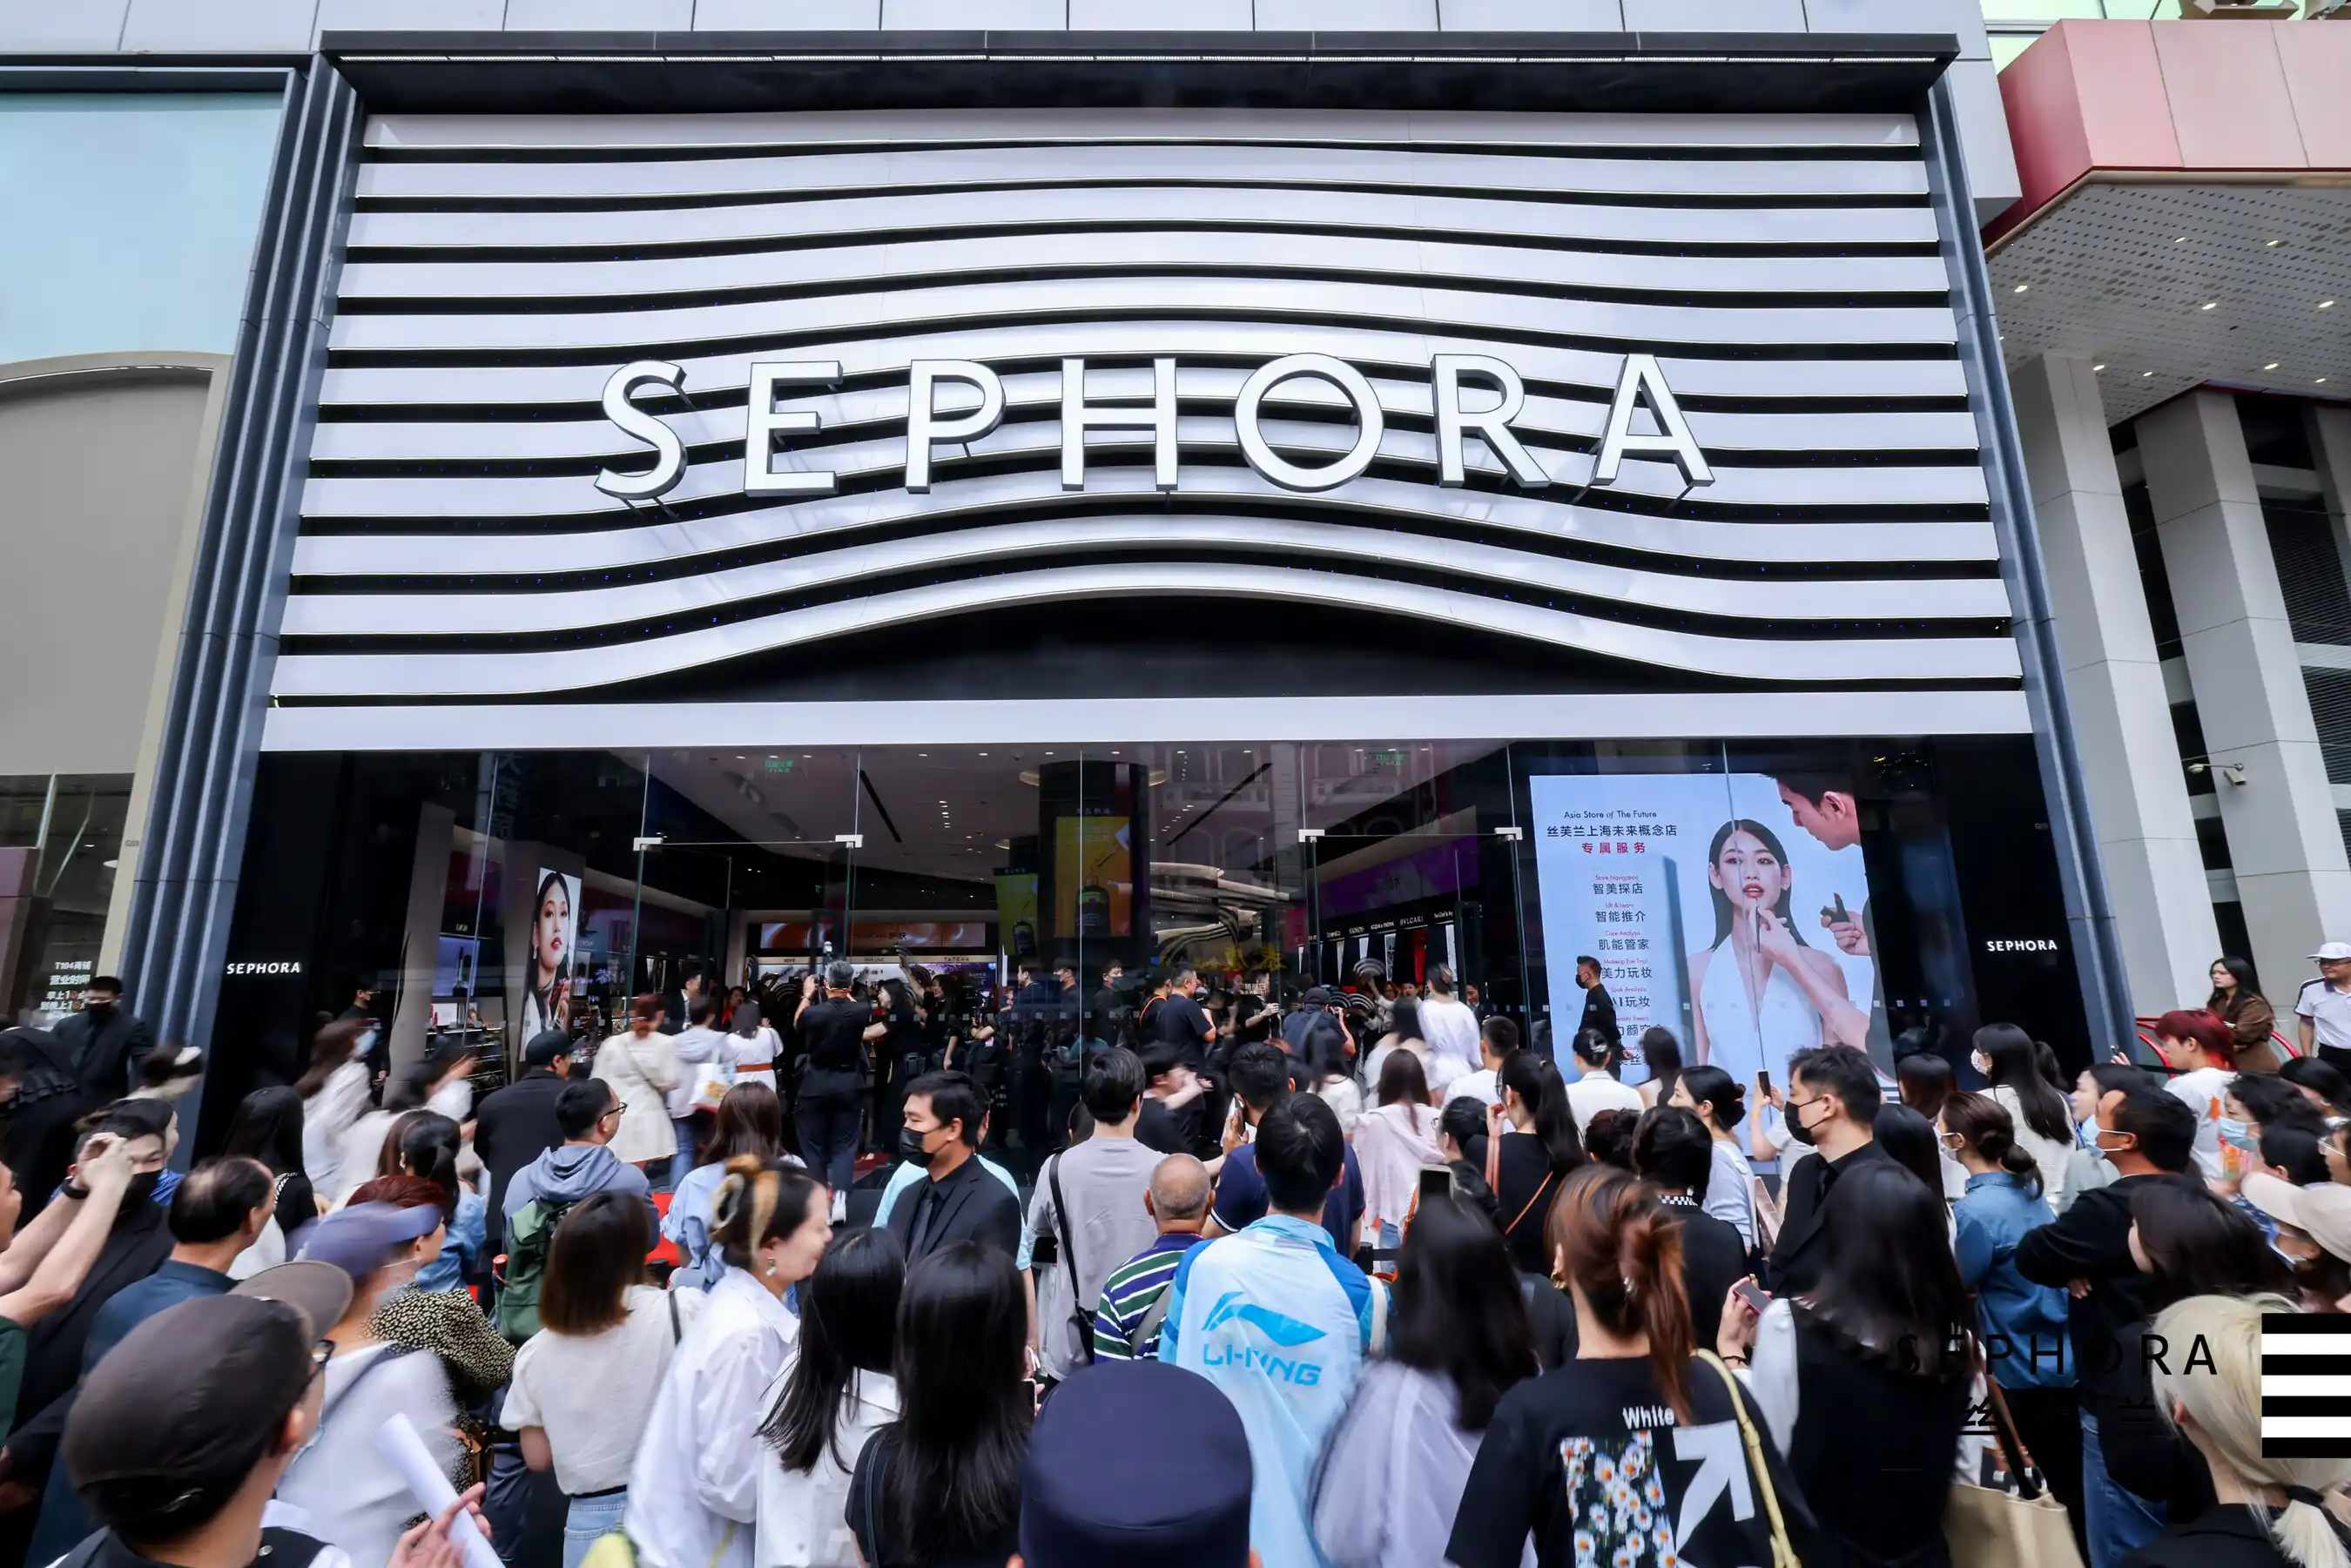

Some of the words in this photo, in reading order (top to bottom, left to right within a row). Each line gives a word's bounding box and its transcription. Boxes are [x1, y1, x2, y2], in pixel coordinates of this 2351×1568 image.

[594, 352, 1715, 501] SEPHORA
[1607, 811, 1614, 819] of
[1546, 824, 1677, 838] 丝芙兰上海未来概念店
[1581, 842, 1646, 853] 专属服务
[1593, 883, 1643, 895] 智美探店
[1399, 916, 1424, 925] BVLGARI
[1595, 911, 1646, 923] 智能推介
[1599, 939, 1649, 951] 肌能管家
[1986, 939, 2058, 952] SEPHORA
[226, 961, 301, 975] SEPHORA
[1601, 966, 1653, 979] 美力玩妆
[1622, 1405, 1675, 1430] White
